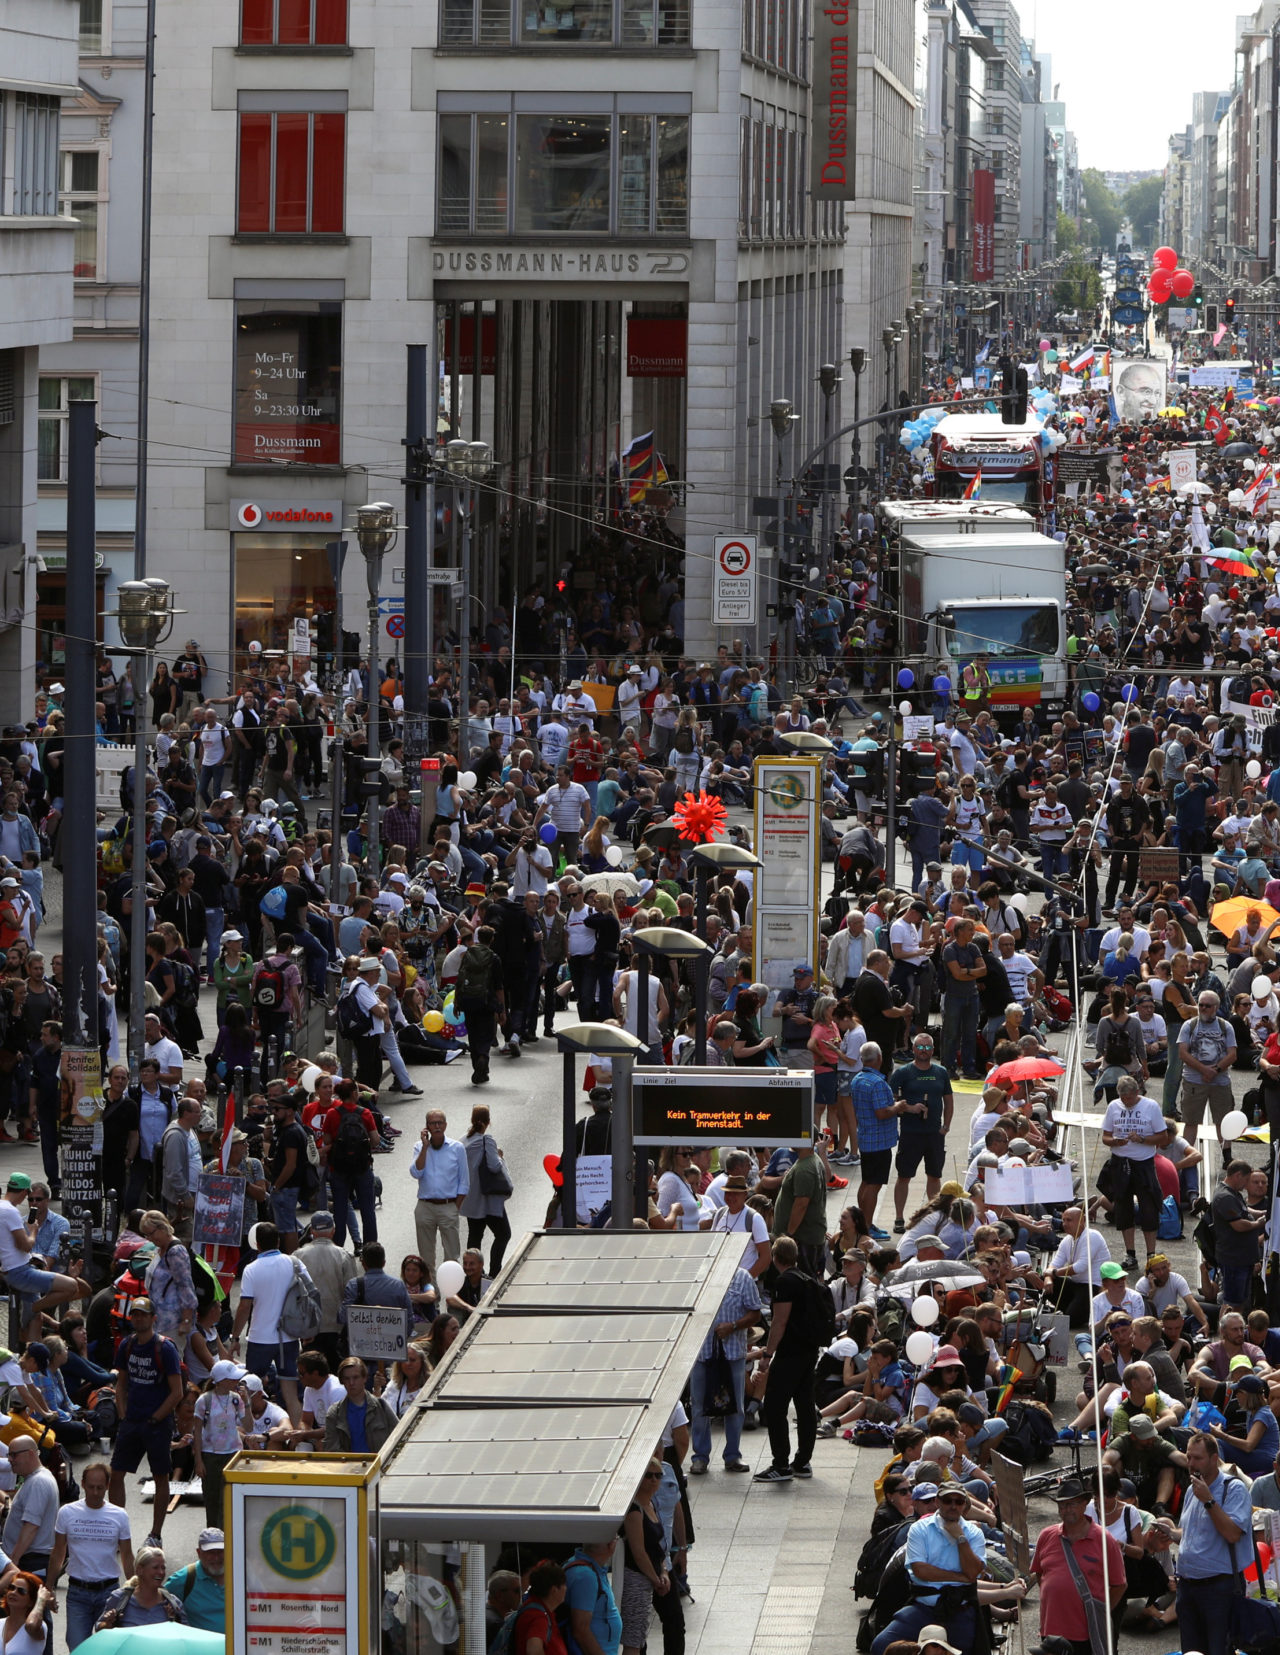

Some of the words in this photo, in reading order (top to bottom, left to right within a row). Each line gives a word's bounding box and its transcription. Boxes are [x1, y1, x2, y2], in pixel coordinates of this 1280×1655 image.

[821, 35, 849, 187] Dussmann
[433, 252, 640, 273] DUSSMANN-HAUS
[629, 355, 684, 366] Dussmann
[286, 368, 307, 379] Uhr
[254, 389, 268, 400] Sa
[302, 406, 322, 417] Uhr
[254, 434, 321, 448] Dussmann
[969, 451, 1021, 465] Altmann
[266, 508, 333, 522] vodafone
[721, 603, 747, 611] Anlieger
[990, 669, 1027, 683] ACE
[66, 1055, 96, 1065] Jenifer
[643, 1077, 659, 1085] Linie
[664, 1077, 677, 1085] Ziel
[768, 1078, 792, 1086] Abfahrt
[793, 1078, 802, 1086] in
[667, 1110, 686, 1120] Kein
[690, 1110, 740, 1121] Tramverkehr
[744, 1111, 754, 1120] in
[756, 1111, 771, 1121] der
[695, 1119, 744, 1129] Innenstadt.
[63, 1150, 93, 1161] RUHIG
[63, 1178, 94, 1190] DILDOS
[350, 1311, 373, 1324] Selbst
[375, 1312, 402, 1326] denken
[73, 1527, 113, 1535] QUERDENKEN
[258, 1604, 272, 1613] M1
[320, 1604, 339, 1613] Nord
[258, 1637, 272, 1646] M1
